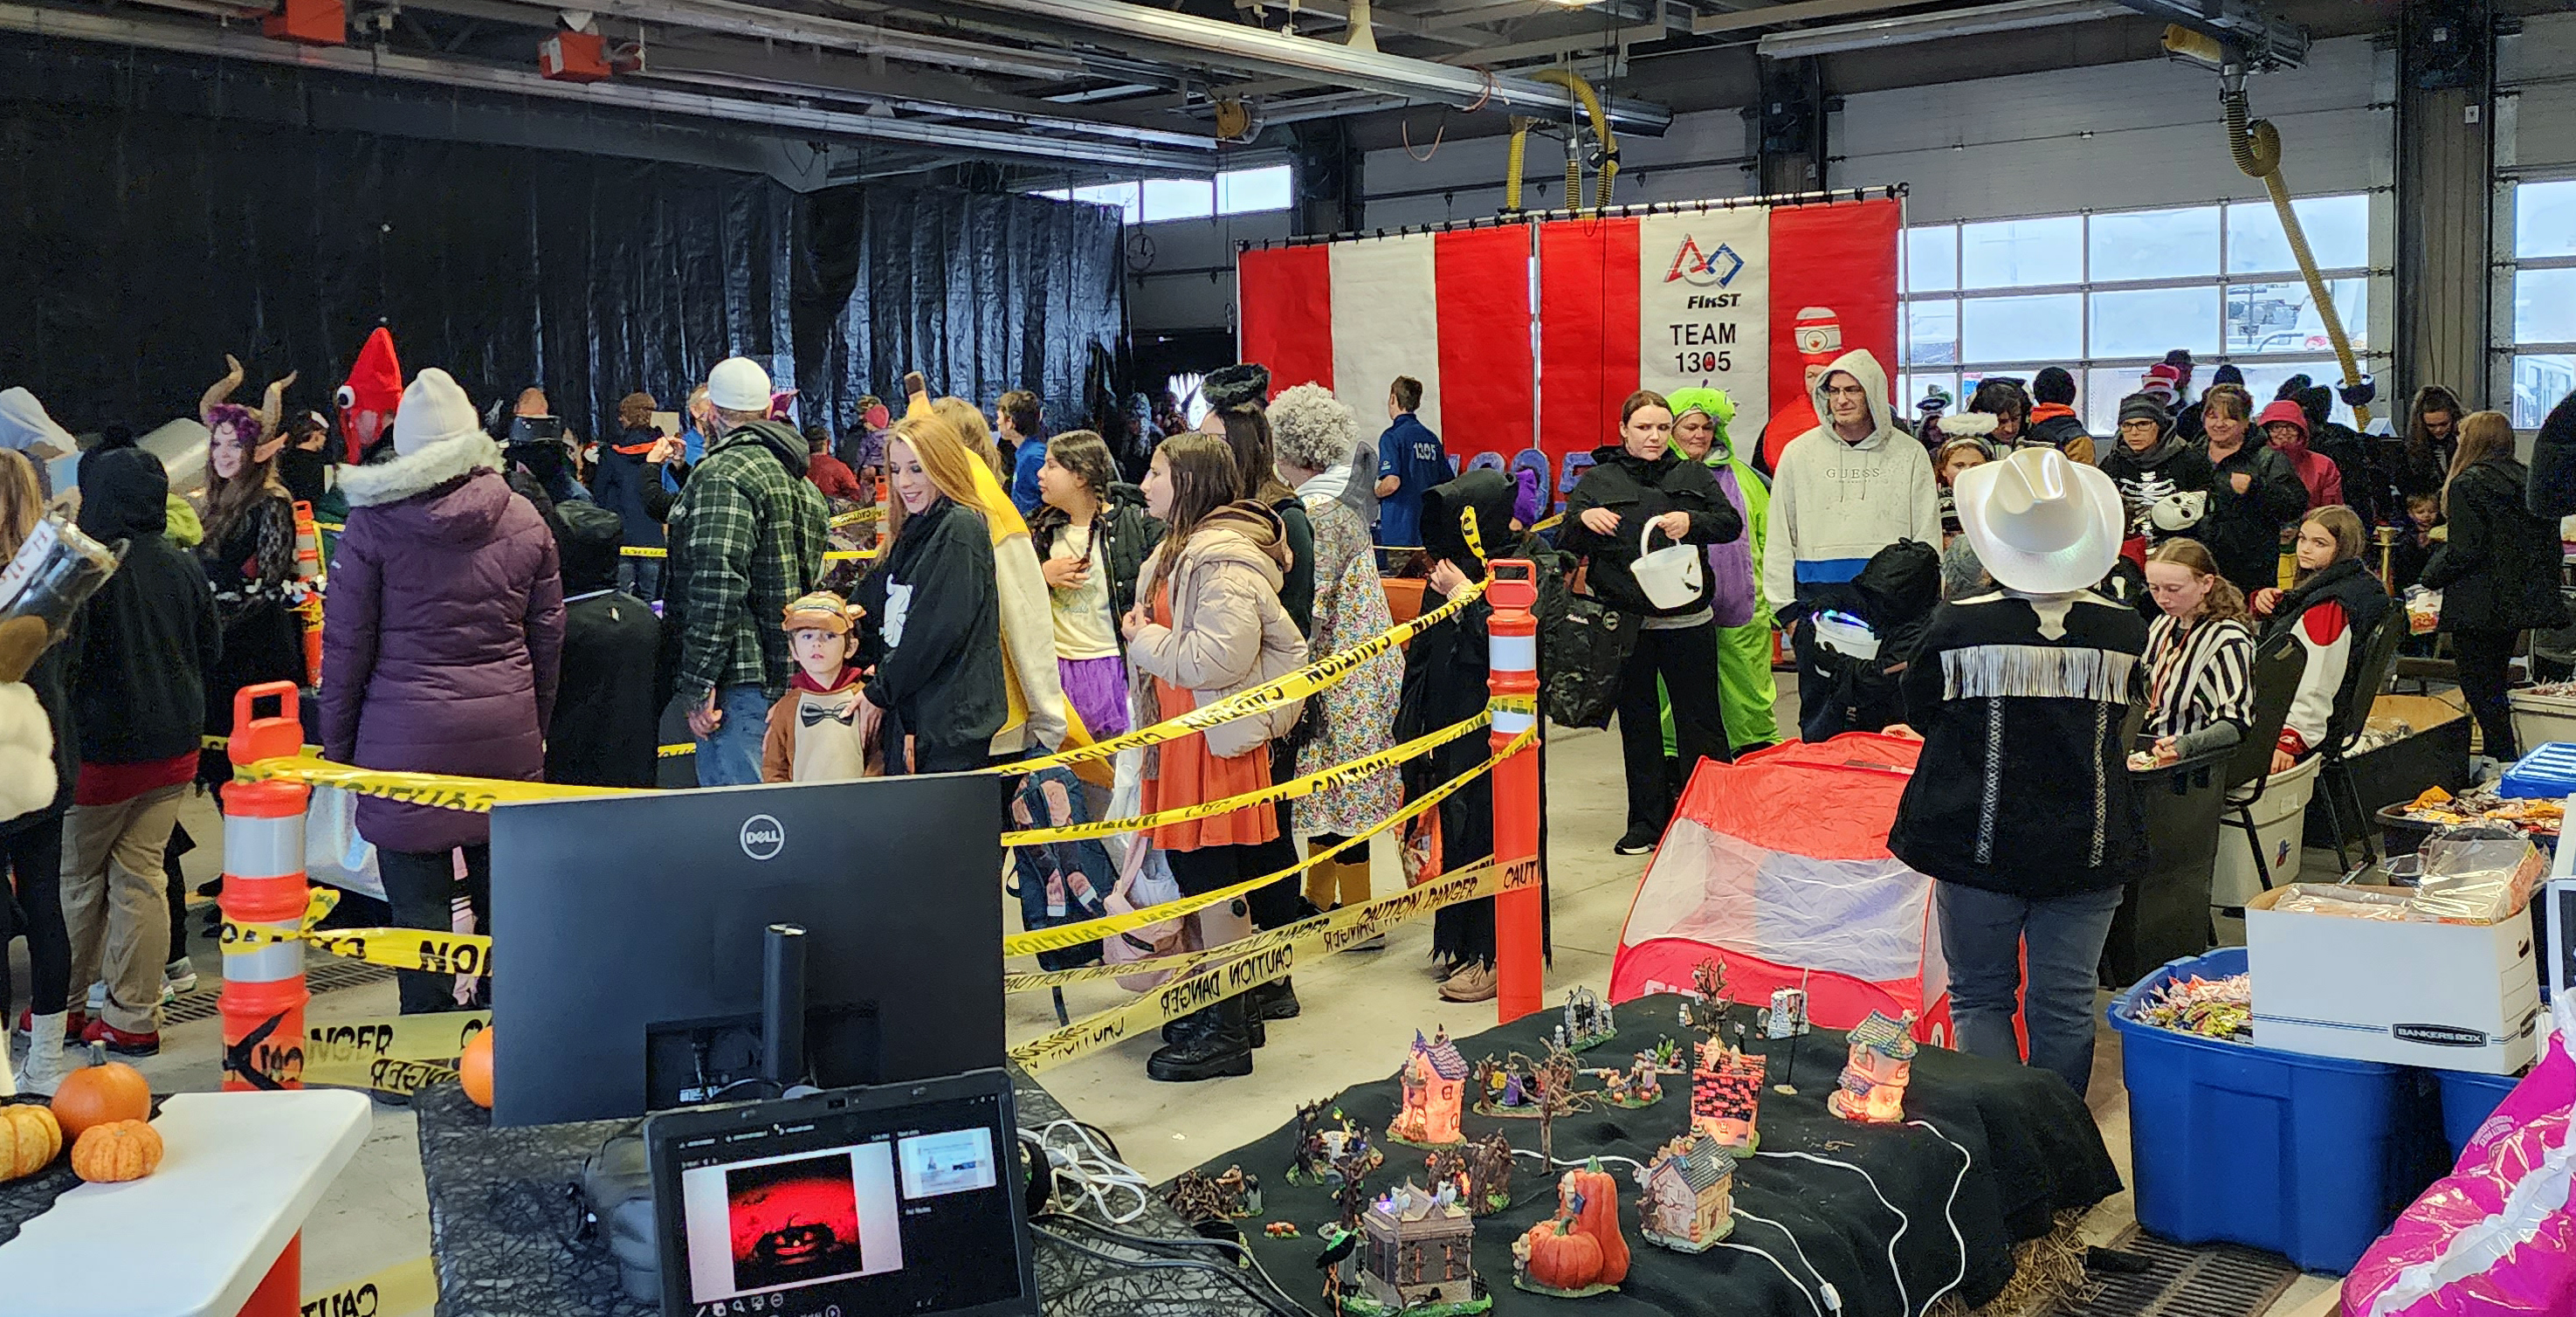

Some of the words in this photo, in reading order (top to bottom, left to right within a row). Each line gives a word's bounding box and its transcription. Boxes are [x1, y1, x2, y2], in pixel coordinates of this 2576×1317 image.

[1687, 293, 1741, 309] FIRST
[1670, 322, 1737, 346] TEAM
[1675, 350, 1732, 374] 1305
[1413, 441, 1437, 461] 1305
[1826, 467, 1880, 479] GUESS
[746, 830, 781, 845] DELL
[1355, 890, 1422, 925] CAUTION
[1424, 876, 1478, 909] DANGER
[1503, 859, 1539, 889] CAUT
[1265, 917, 1331, 948] DANGER
[310, 1024, 394, 1062] NGER
[2397, 1027, 2455, 1040] BANKERS
[2455, 1033, 2483, 1043] BOX
